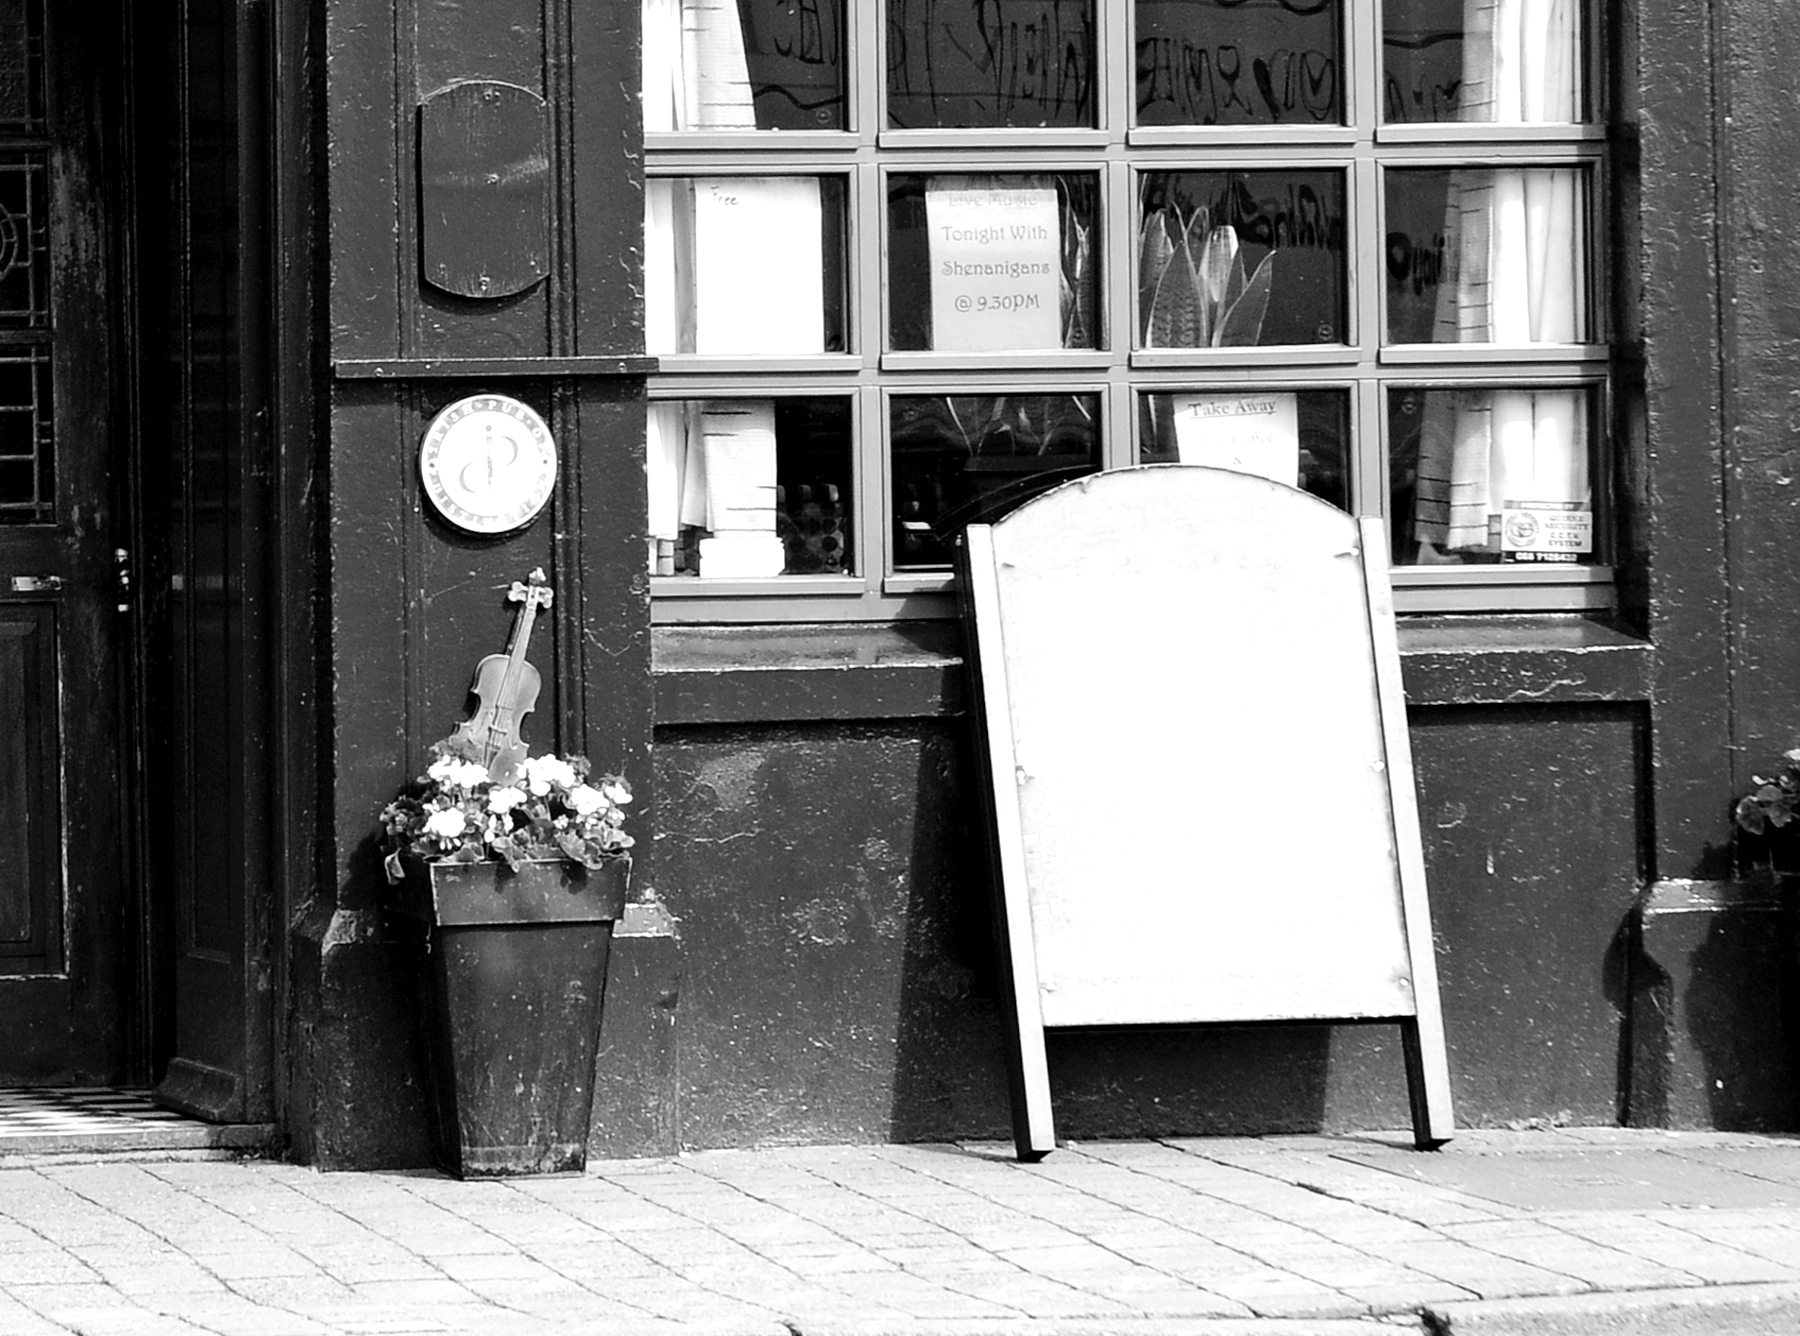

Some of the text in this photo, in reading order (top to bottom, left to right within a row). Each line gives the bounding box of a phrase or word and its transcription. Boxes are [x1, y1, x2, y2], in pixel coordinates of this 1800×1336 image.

[941, 225, 1048, 244] Tonight With
[941, 261, 1051, 278] Shenanigans
[1188, 400, 1276, 416] Take Away
